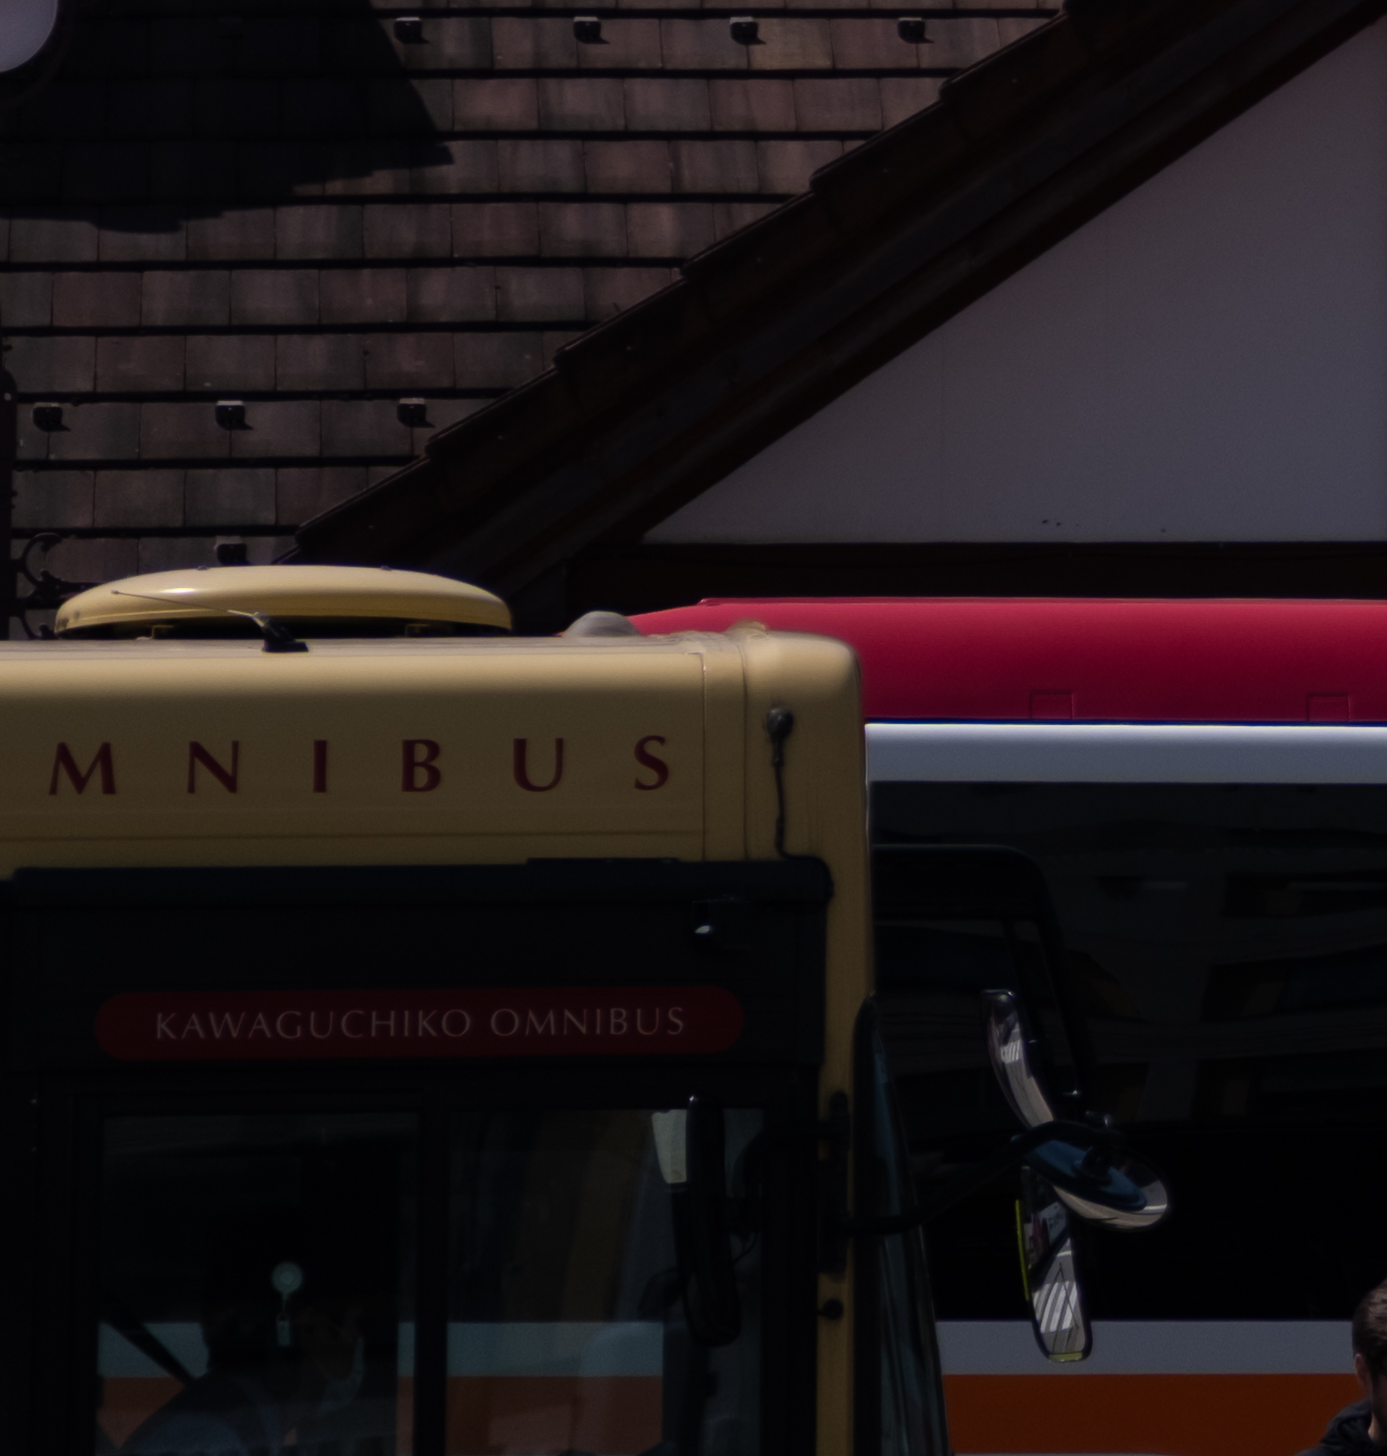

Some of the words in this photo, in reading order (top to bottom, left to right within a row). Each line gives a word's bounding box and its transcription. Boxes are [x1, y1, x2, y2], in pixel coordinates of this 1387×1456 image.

[48, 734, 671, 796] MNIBUS
[155, 1009, 473, 1042] KAWAGUCHIKO
[490, 1005, 685, 1037] OMNIBUS
